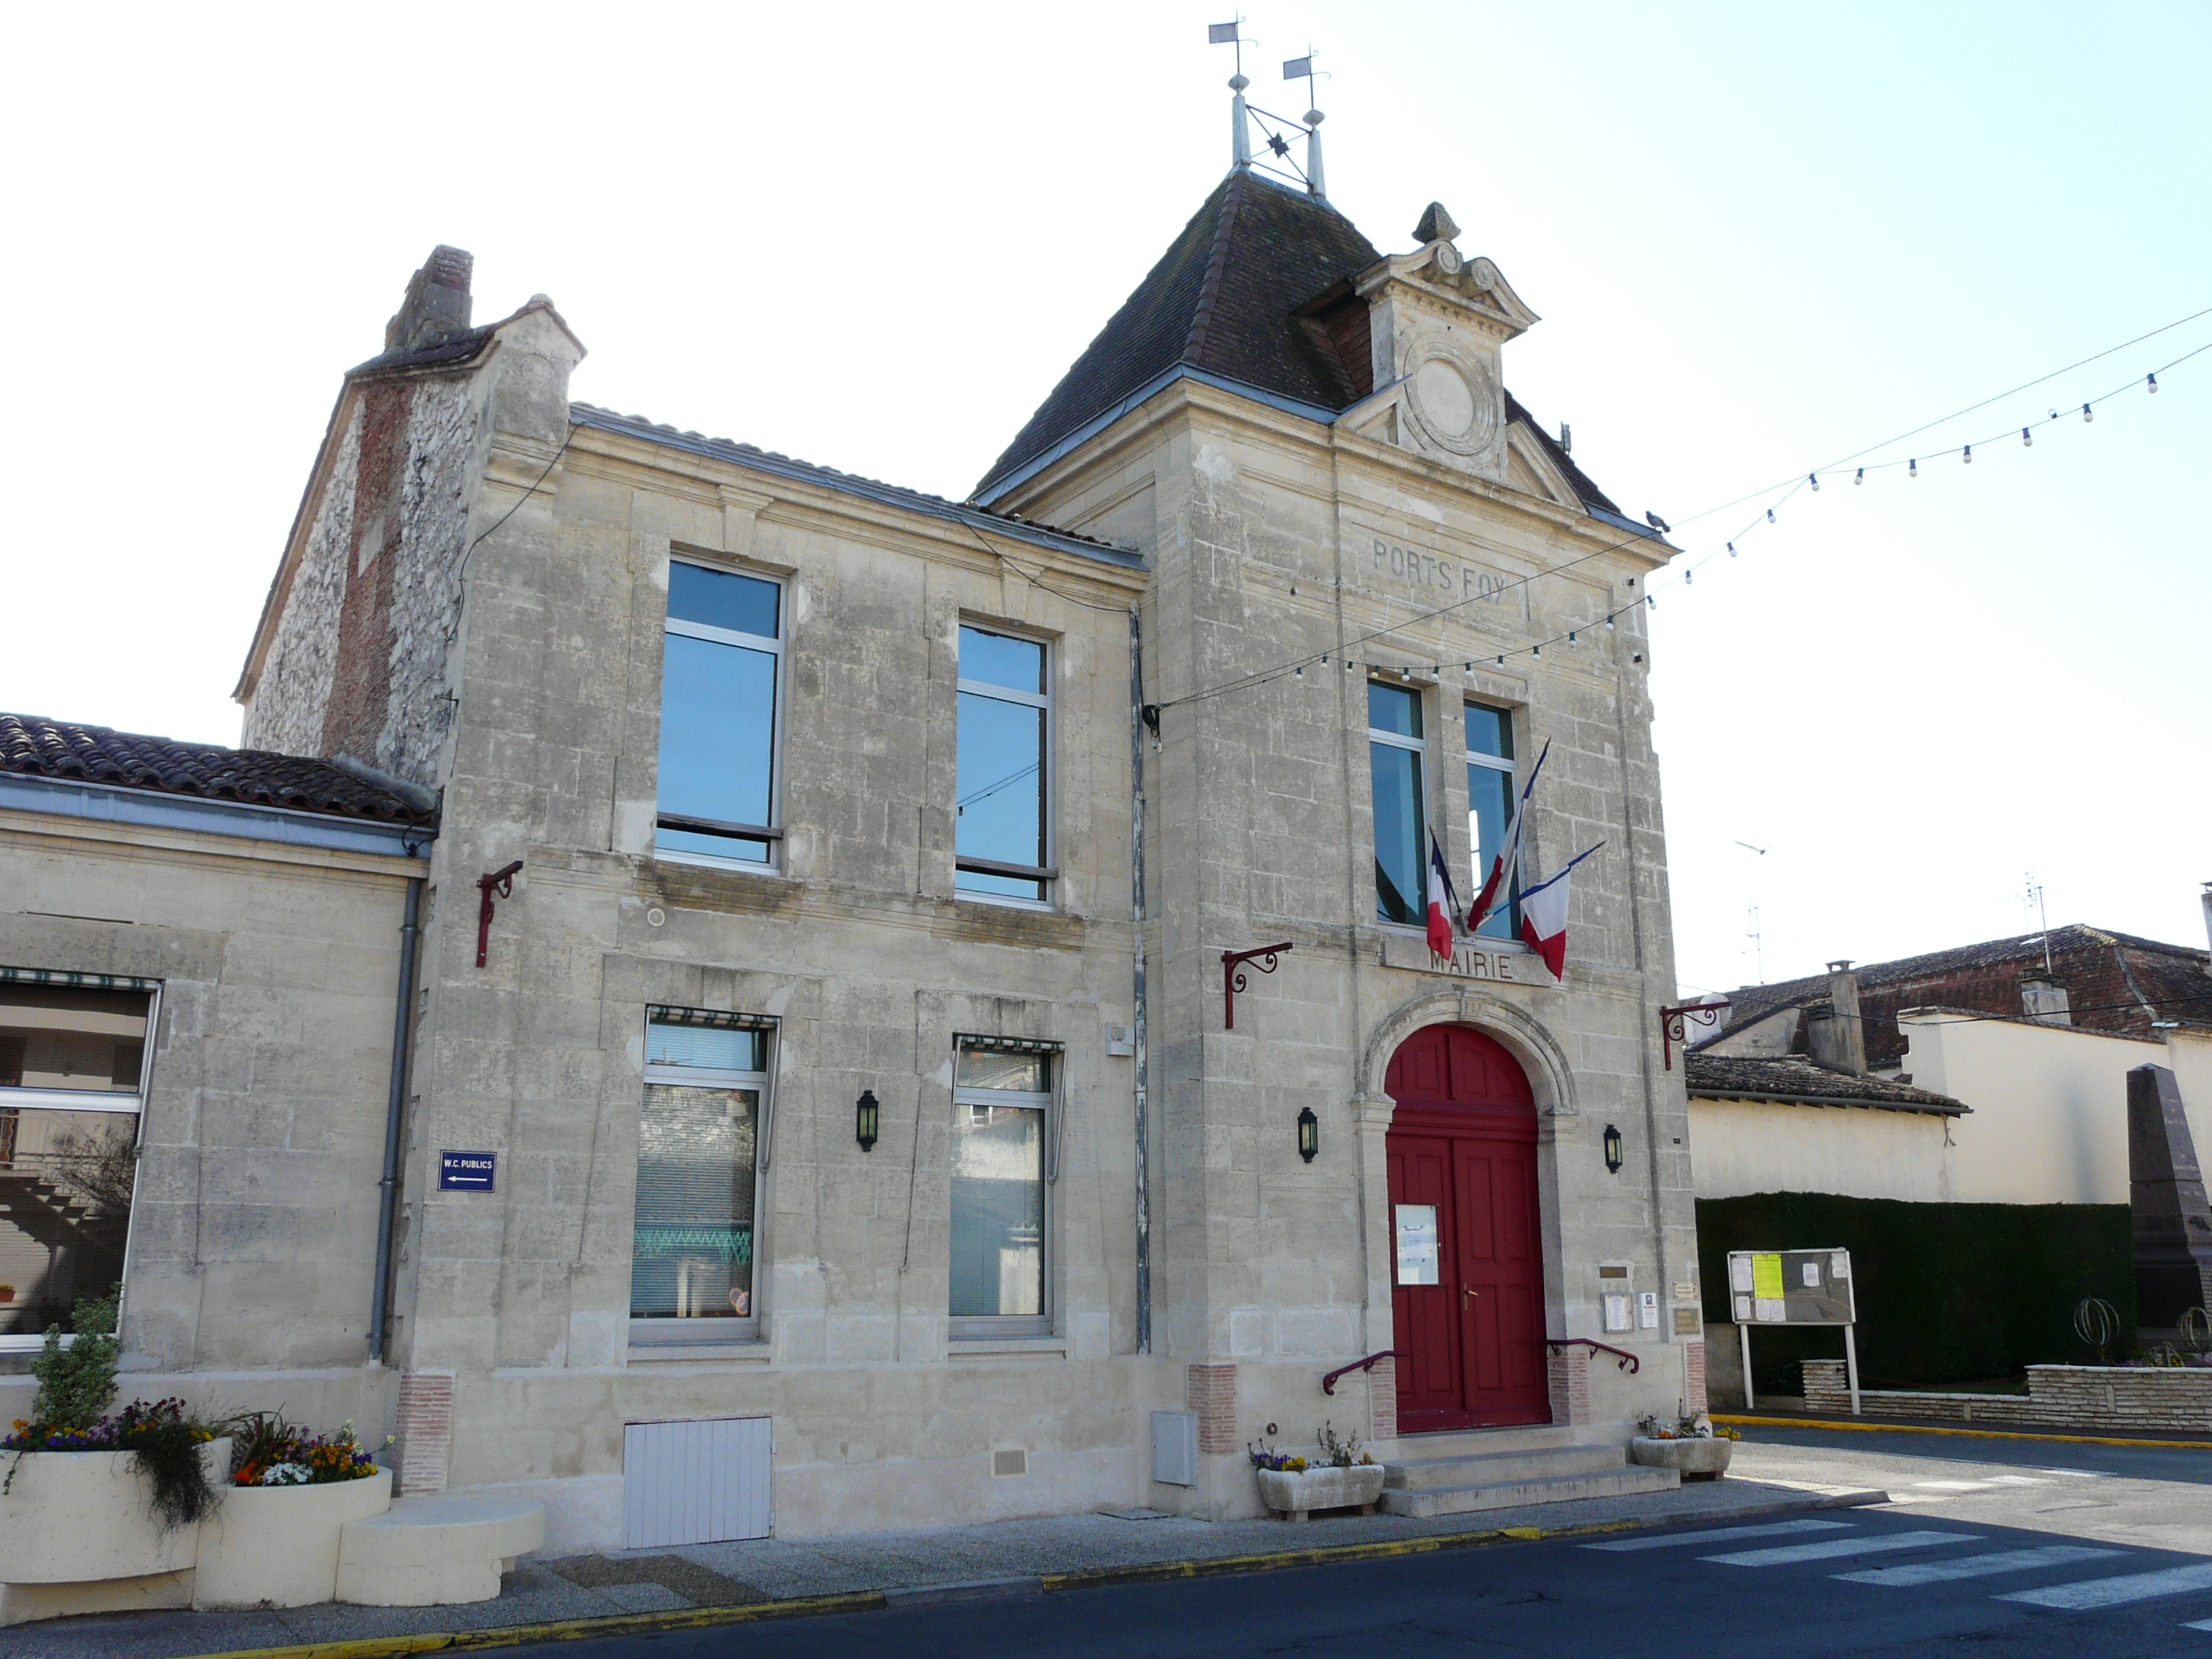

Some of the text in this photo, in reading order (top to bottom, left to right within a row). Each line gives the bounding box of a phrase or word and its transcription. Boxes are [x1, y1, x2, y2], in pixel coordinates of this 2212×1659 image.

[1462, 567, 1505, 605] FOY
[1430, 948, 1513, 979] MAIRIE
[444, 1159, 493, 1170] W.C. PUBLICS
